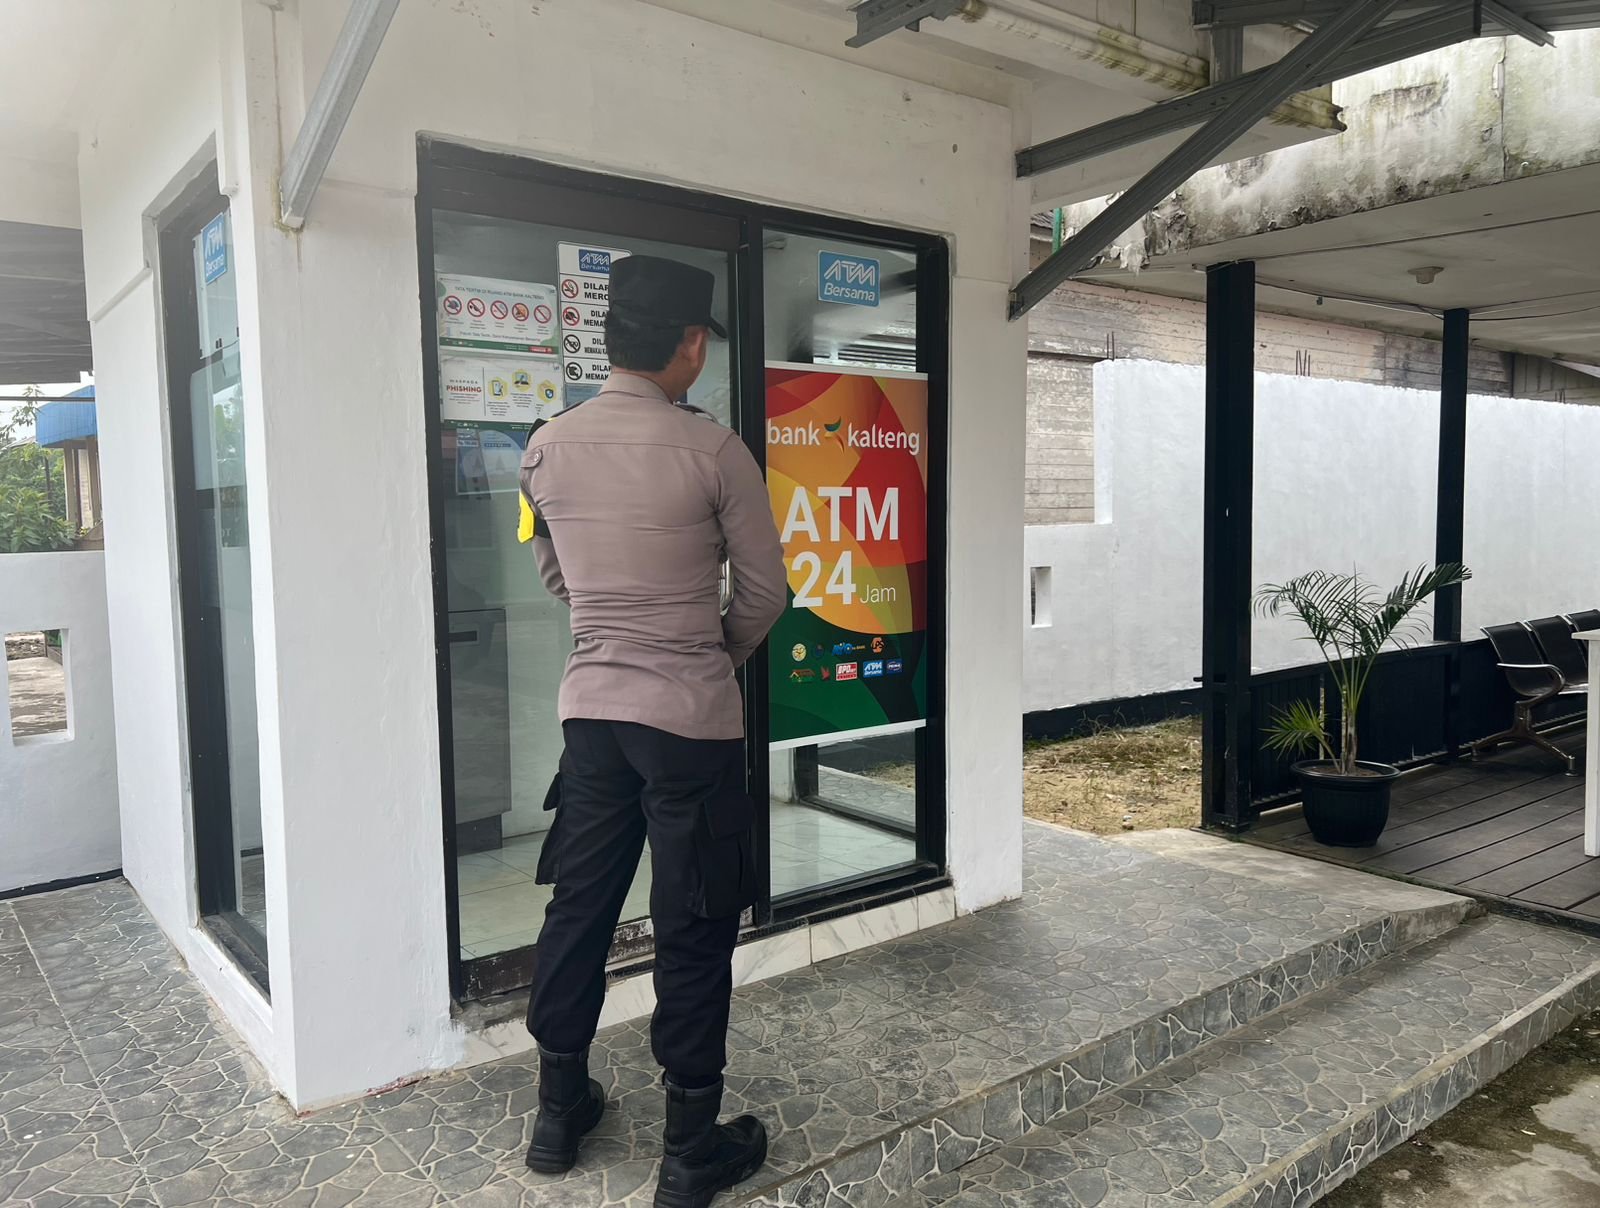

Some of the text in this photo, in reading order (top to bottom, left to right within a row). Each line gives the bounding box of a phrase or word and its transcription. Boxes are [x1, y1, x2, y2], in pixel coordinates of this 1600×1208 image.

[580, 252, 610, 265] ATM
[824, 260, 876, 286] ATM
[583, 282, 610, 291] DILAR
[824, 282, 876, 302] Bersama
[585, 373, 609, 381] MEMAK
[446, 385, 482, 393] PHISHING
[767, 418, 920, 455] bank kalteng
[780, 486, 899, 543] ATM
[792, 551, 896, 608] 24 Jam
